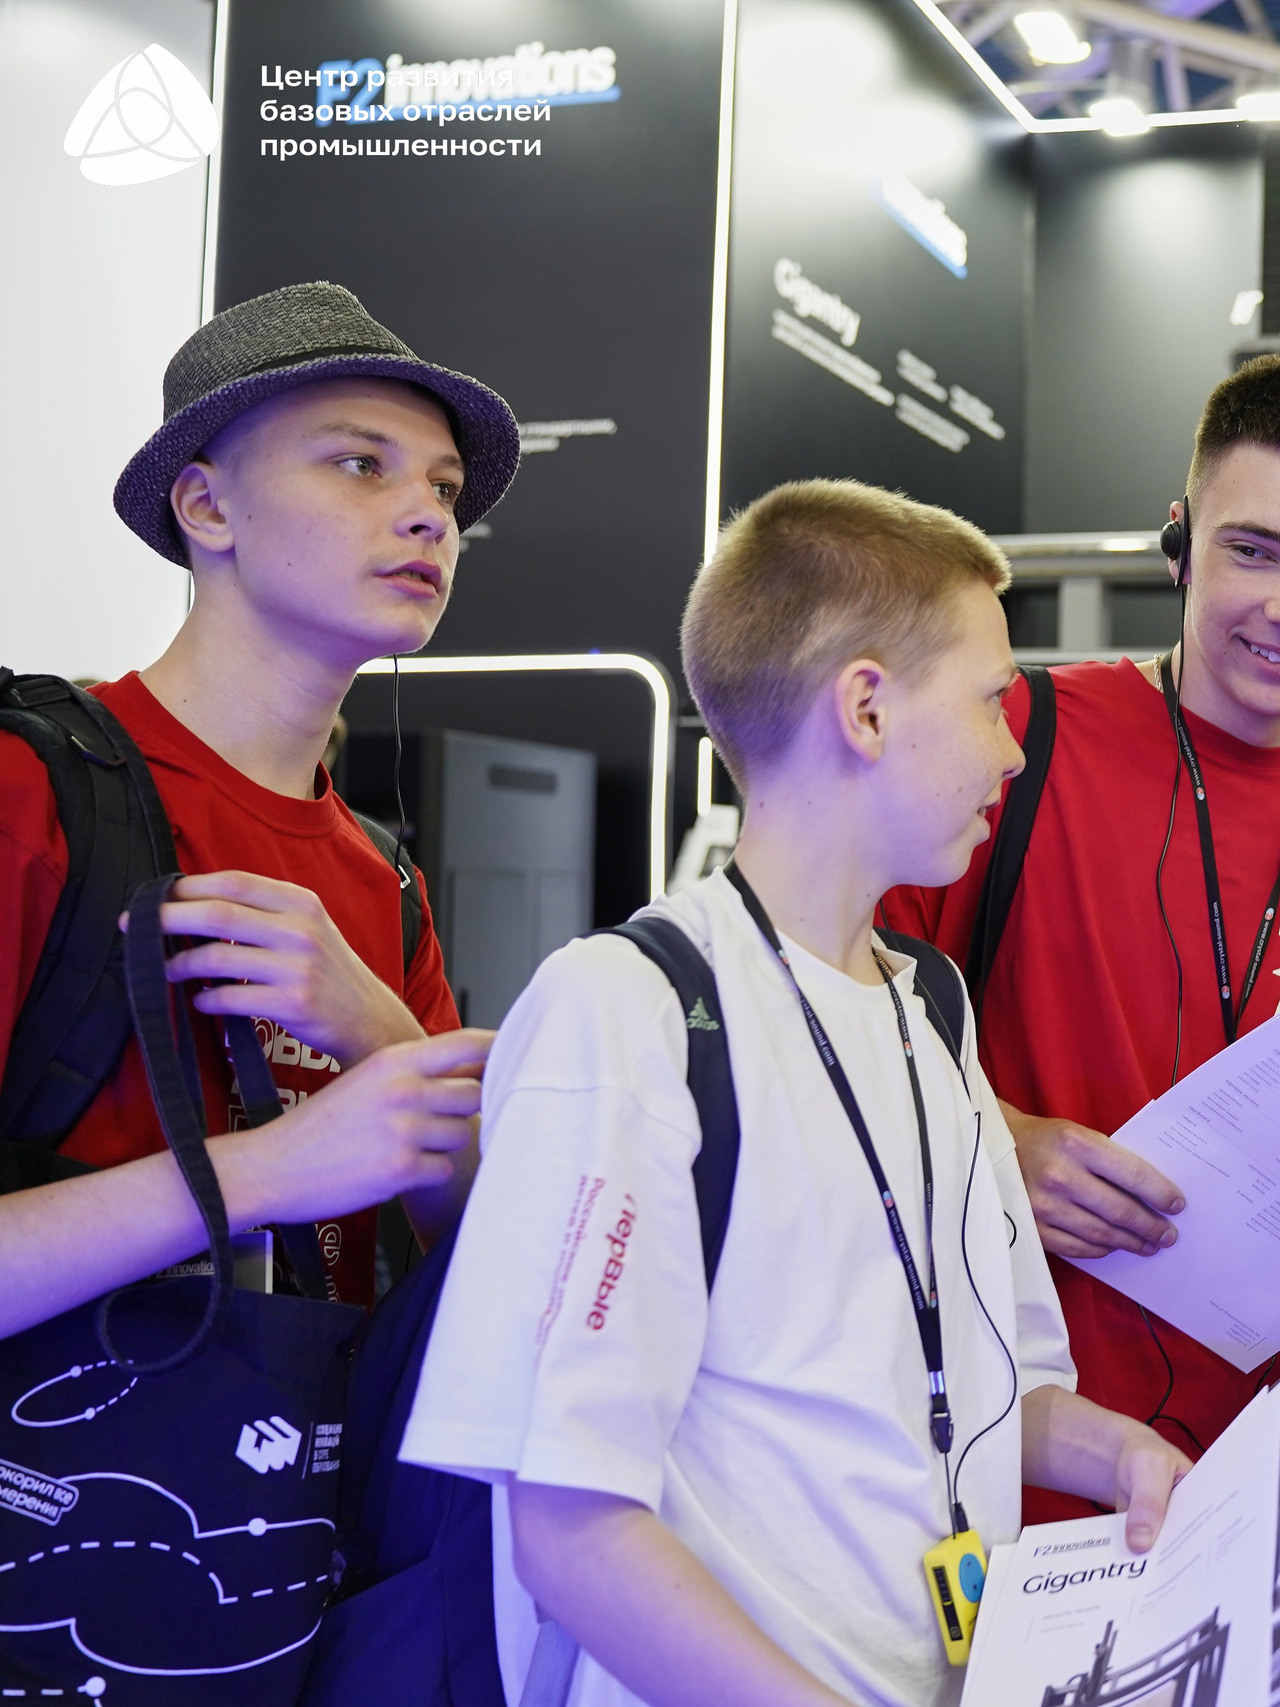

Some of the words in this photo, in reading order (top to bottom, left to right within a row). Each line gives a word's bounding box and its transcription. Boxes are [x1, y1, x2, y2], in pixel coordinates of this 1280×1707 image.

[1213, 902, 1226, 985] www.crystal-sound.com
[166, 1261, 214, 1275] innovatio
[889, 1208, 924, 1310] www.crystal-sound.com
[0, 1466, 55, 1498] окорил
[1033, 1545, 1052, 1557] F2
[1023, 1558, 1148, 1594] Gigantry
